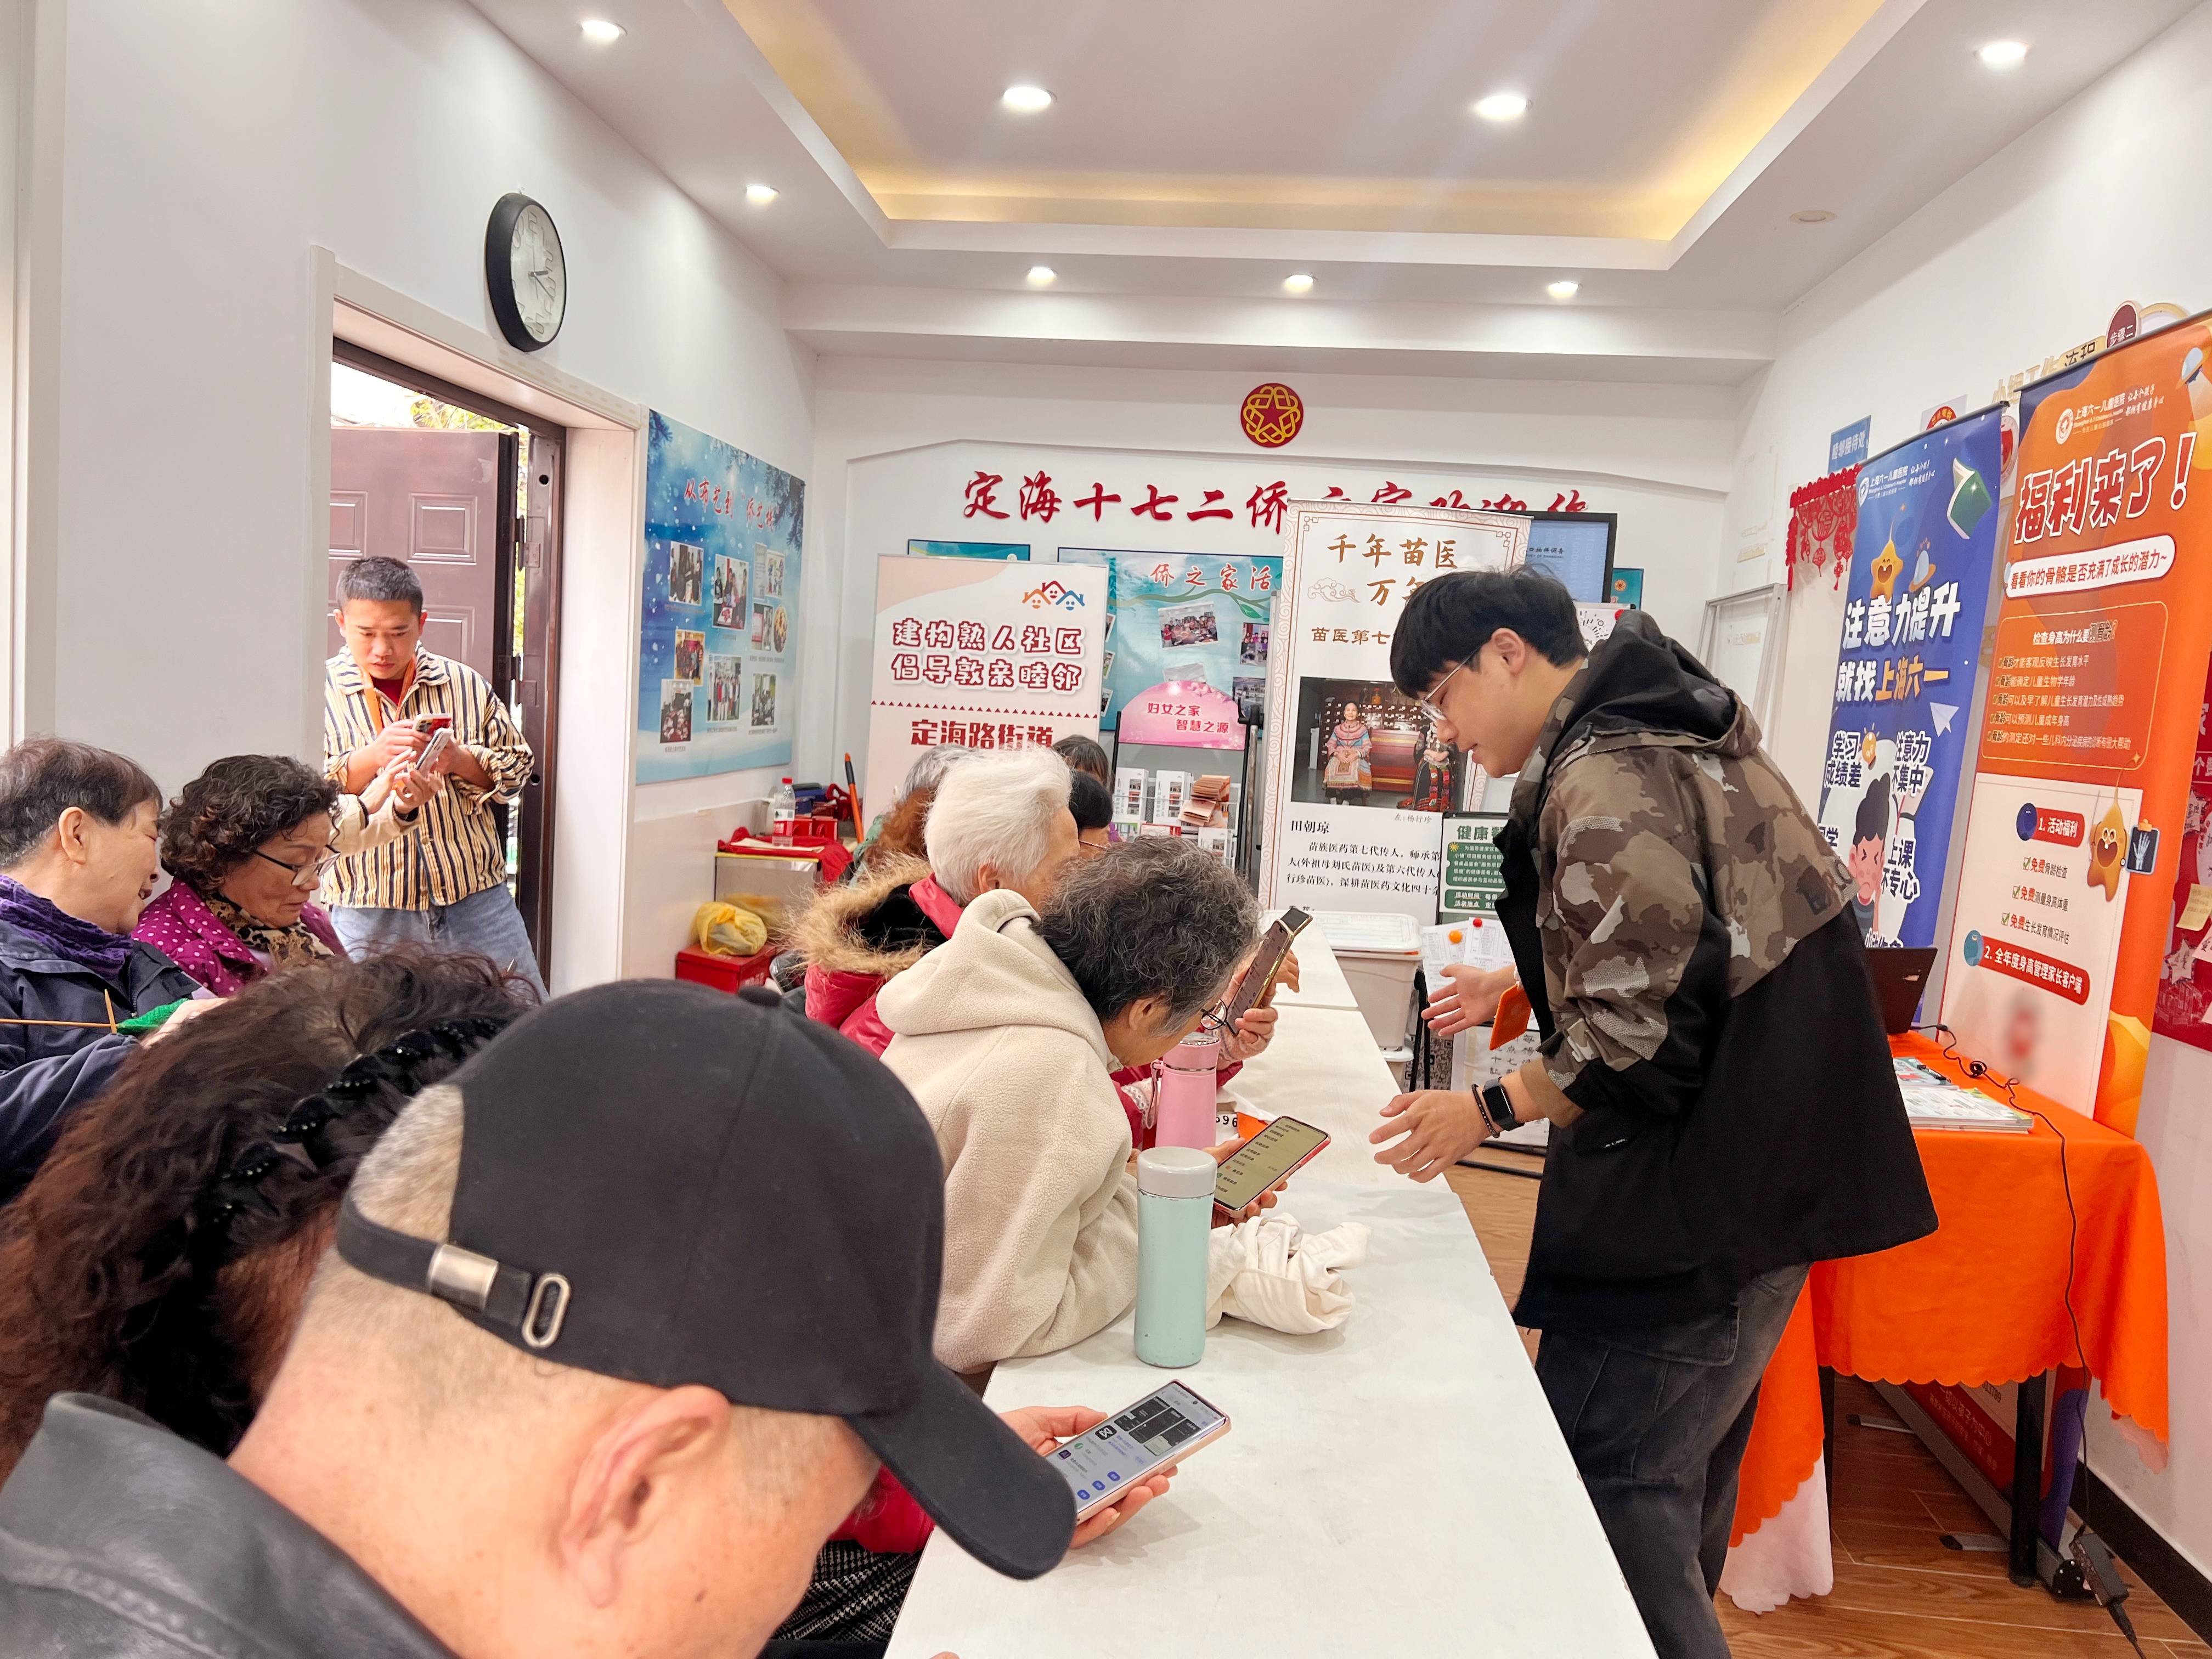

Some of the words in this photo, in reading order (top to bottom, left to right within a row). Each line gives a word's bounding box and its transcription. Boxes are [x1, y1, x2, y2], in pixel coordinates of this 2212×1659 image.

[2110, 324, 2134, 346] 步骤二
[1327, 533, 1458, 569] 千年苗医
[1150, 562, 1272, 591] 侨之家活
[1842, 581, 1961, 650] 注意力提升
[892, 617, 1084, 656] 建构熟人社区
[891, 653, 1082, 692] 倡导敦亲睦邻
[1836, 654, 1949, 703] 就找上海六一
[1147, 702, 1201, 718] 妇女之家
[1176, 719, 1230, 735] 智慧之源
[1833, 731, 1859, 760] 学习
[1896, 731, 1930, 763] 注意力
[1825, 759, 1862, 788] 成绩差
[1892, 764, 1925, 794] 不集中
[1291, 820, 1330, 834] 田朝琼
[2047, 817, 2078, 838] 活动福利
[1887, 839, 1914, 868] 上课
[2031, 857, 2068, 879] 免费骨龄检查
[1881, 866, 1919, 901] 不专心
[2020, 885, 2068, 912] 免费测量身高体重
[1994, 948, 2083, 995] 全年度身高管理家长客户端
